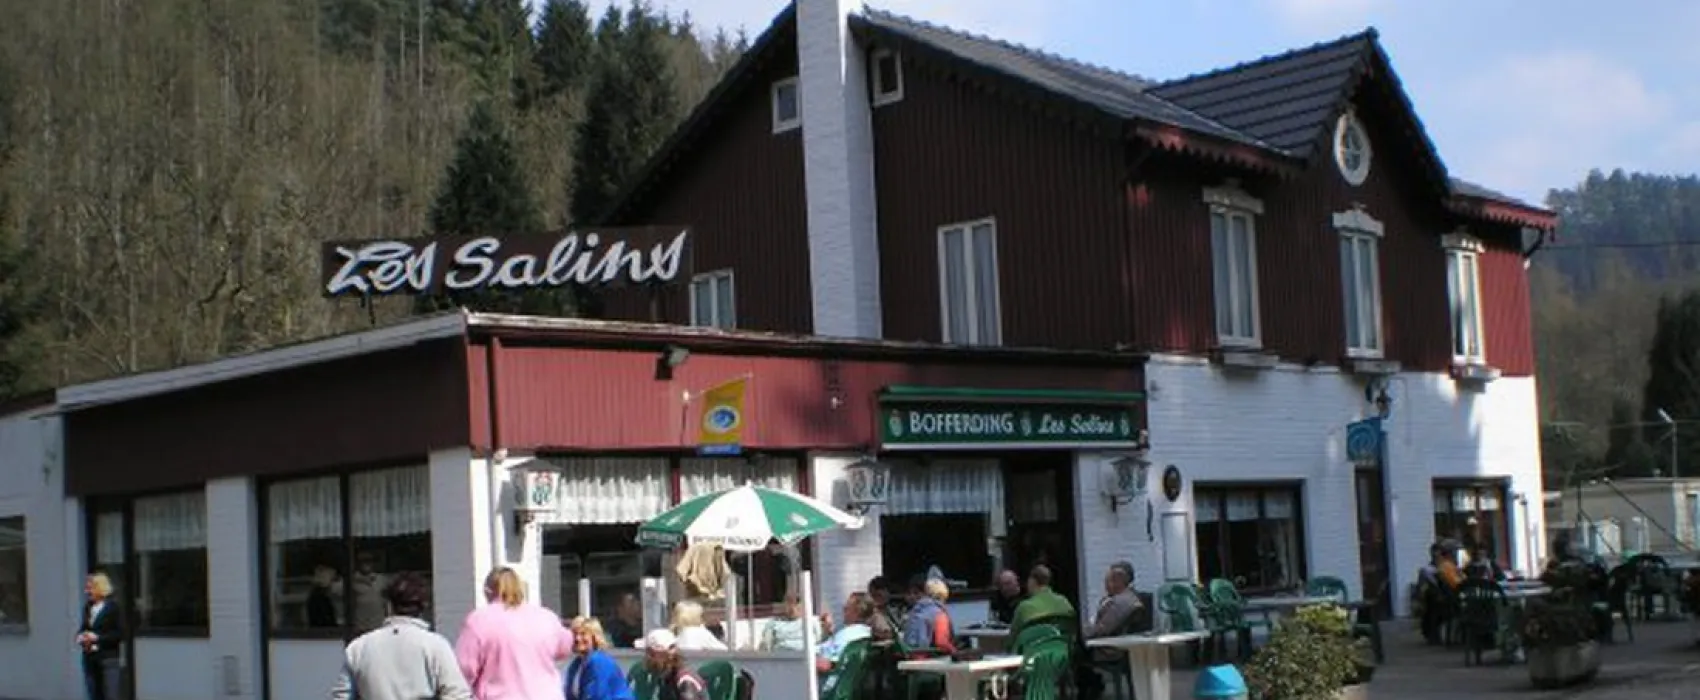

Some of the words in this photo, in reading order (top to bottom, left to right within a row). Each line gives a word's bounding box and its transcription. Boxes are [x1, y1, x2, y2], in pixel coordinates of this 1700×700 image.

[326, 239, 437, 294] Les
[445, 230, 687, 289] Salins
[909, 411, 1014, 434] BOFFERDING
[1037, 413, 1066, 434] Les
